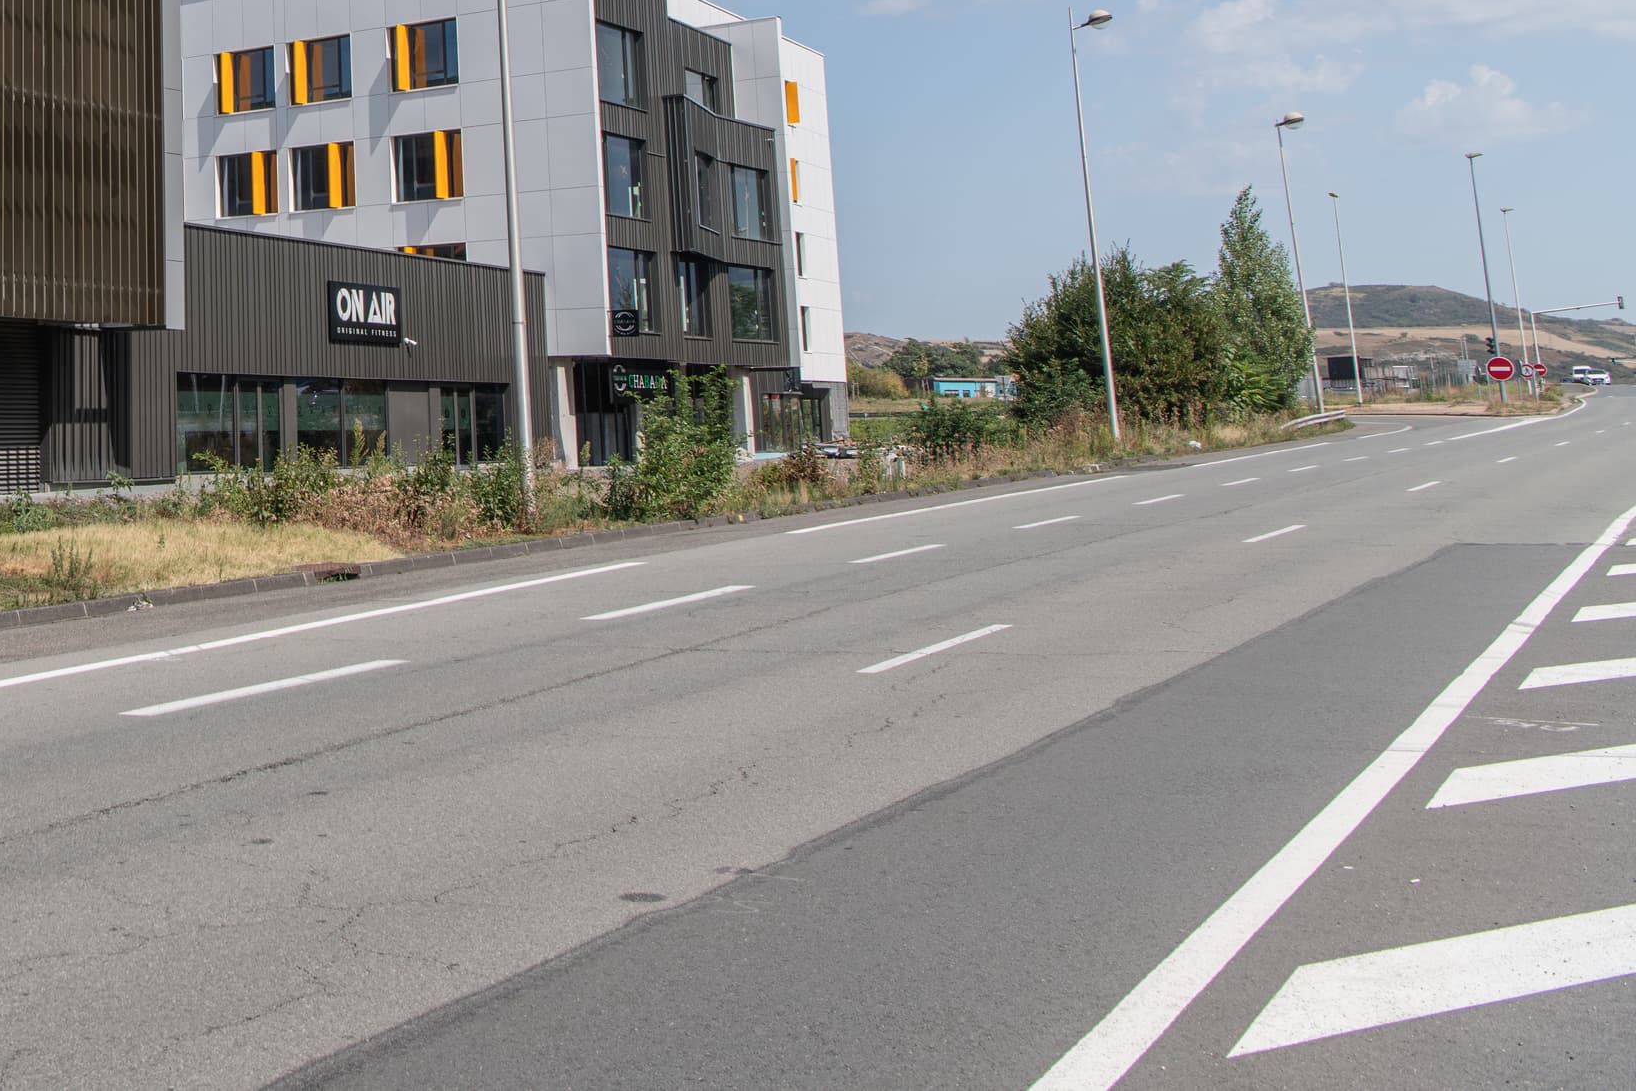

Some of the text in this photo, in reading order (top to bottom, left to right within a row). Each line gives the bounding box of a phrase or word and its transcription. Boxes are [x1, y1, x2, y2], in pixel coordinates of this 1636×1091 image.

[336, 288, 397, 325] ON AIR
[337, 327, 396, 337] ORIGINAL FITNESS
